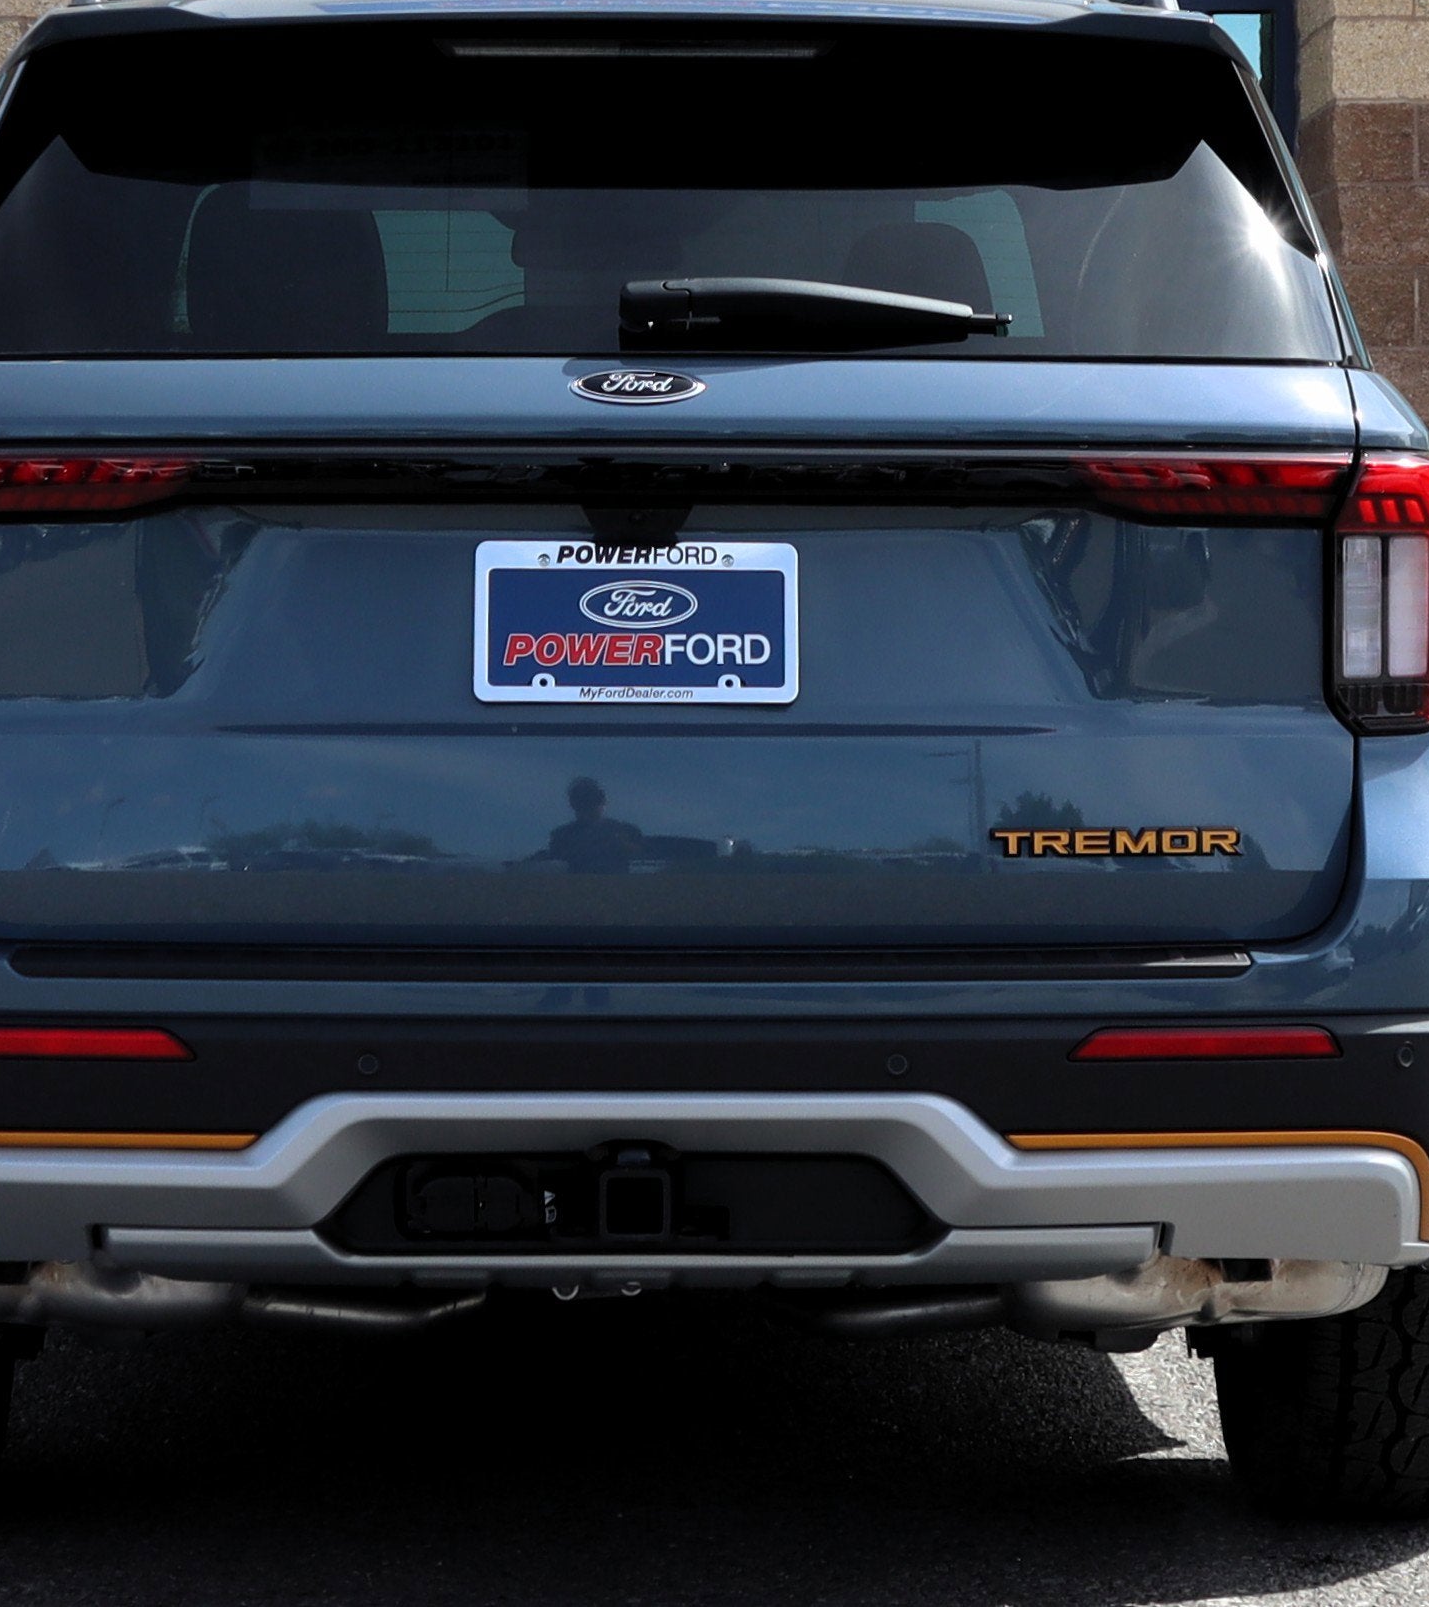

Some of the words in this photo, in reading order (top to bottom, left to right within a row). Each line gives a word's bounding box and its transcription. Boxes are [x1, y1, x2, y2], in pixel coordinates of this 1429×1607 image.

[601, 373, 674, 392] Ford
[604, 589, 673, 617] Ford
[503, 633, 771, 666] POWERFORD
[579, 686, 693, 700] MyFordDealer.com
[991, 828, 1242, 856] TREMOR
